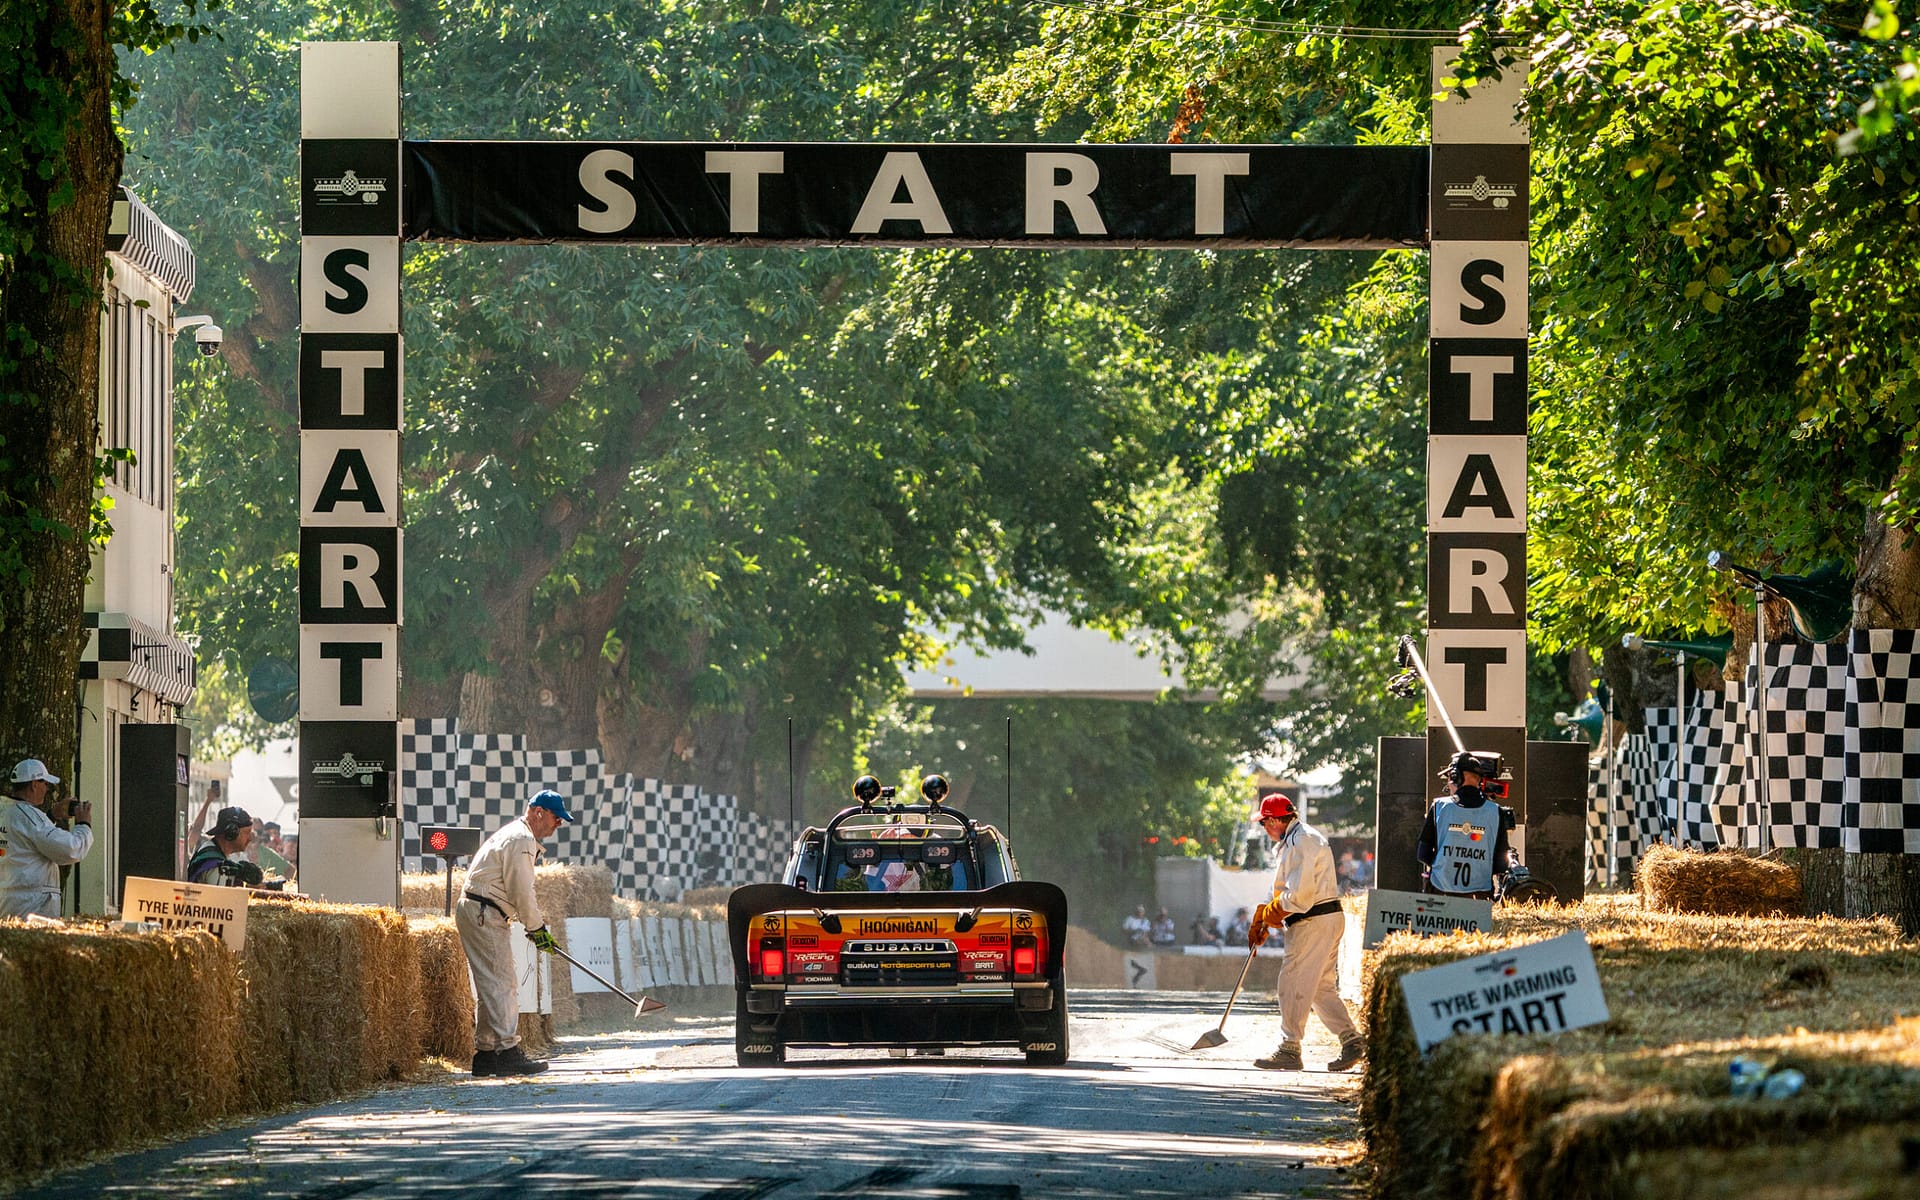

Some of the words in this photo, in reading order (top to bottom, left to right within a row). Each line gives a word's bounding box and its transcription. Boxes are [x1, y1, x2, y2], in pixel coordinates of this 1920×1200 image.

[577, 149, 1251, 236] START
[311, 248, 387, 708] START
[1441, 258, 1516, 713] START
[1443, 845, 1455, 857] TV
[1455, 846, 1486, 860] TRACK
[1453, 861, 1471, 888] 70
[138, 900, 169, 914] TYRE
[173, 903, 233, 921] WARMING
[1380, 910, 1412, 925] TYRE
[1416, 914, 1478, 934] WARMING
[863, 943, 935, 952] SUBARU
[1431, 990, 1480, 1020] TYRE
[1482, 965, 1577, 1002] WARMING
[743, 1044, 774, 1054] 4WD
[1027, 1042, 1057, 1051] 4WD
